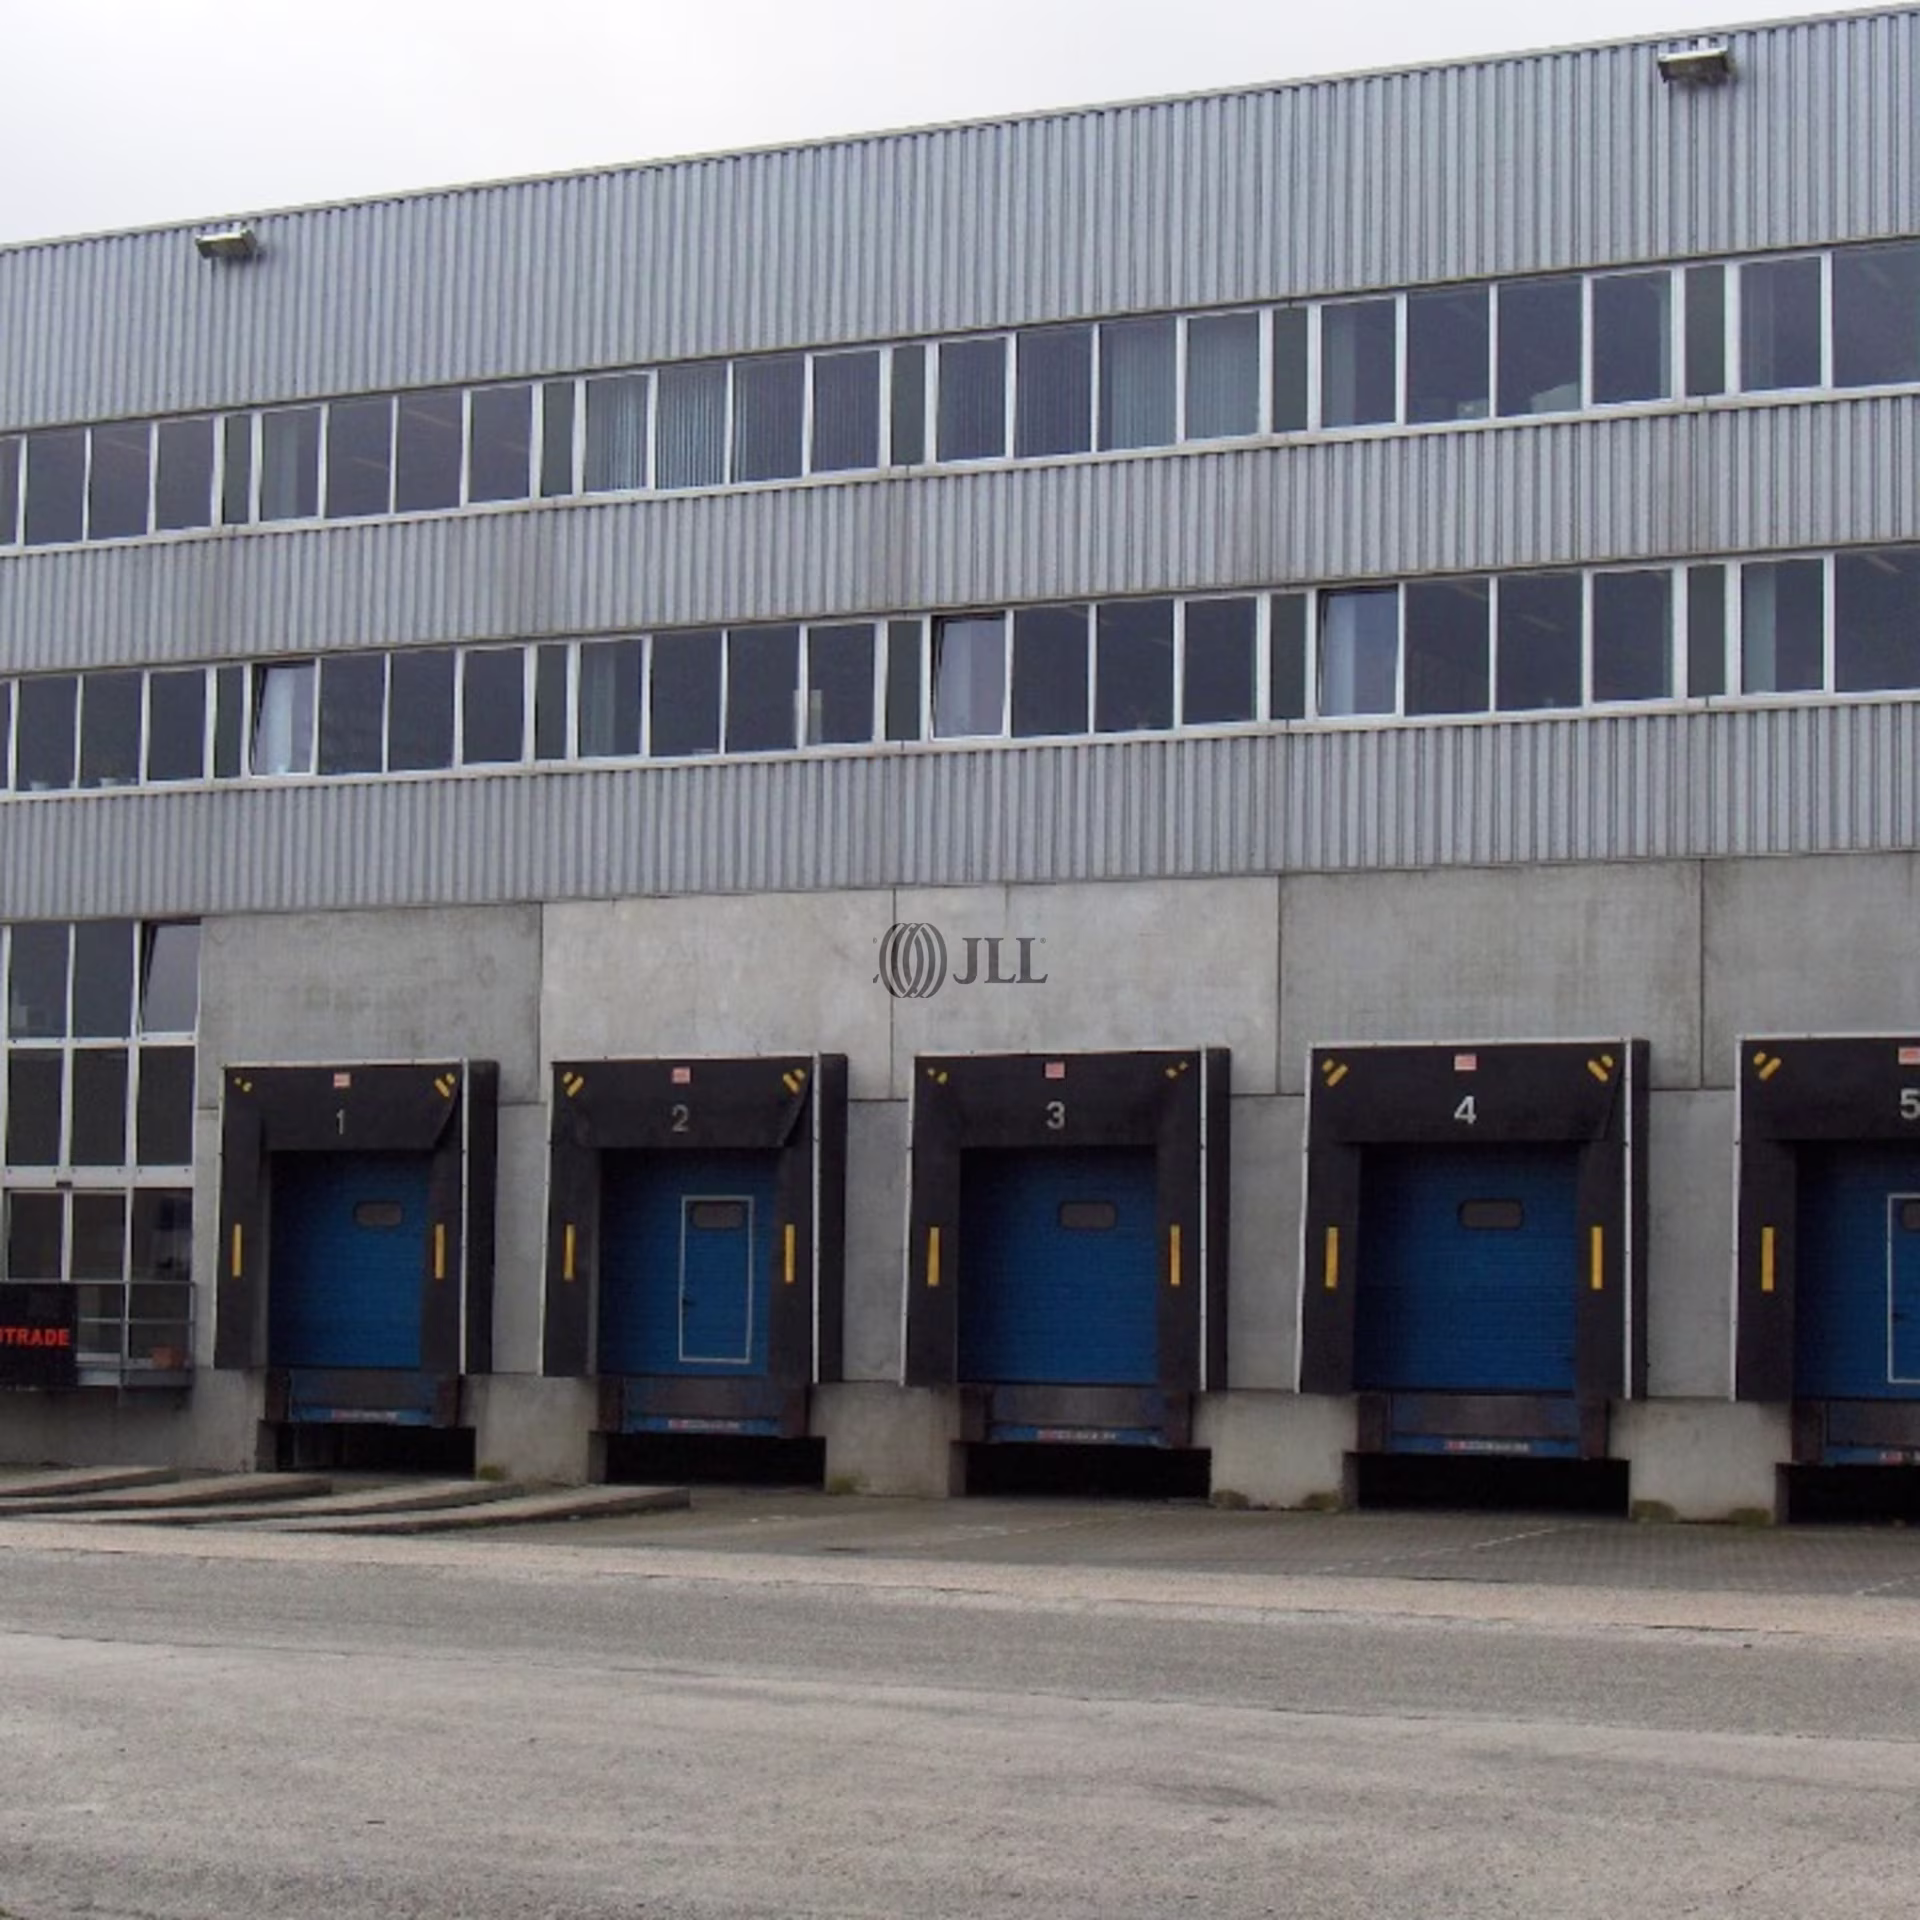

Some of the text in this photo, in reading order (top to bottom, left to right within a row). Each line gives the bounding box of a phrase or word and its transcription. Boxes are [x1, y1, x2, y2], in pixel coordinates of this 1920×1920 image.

[1046, 1101, 1065, 1129] 3
[1454, 1096, 1476, 1124] 4
[1901, 1088, 1920, 1119] 5
[336, 1109, 344, 1135] 1
[672, 1104, 689, 1132] 2
[0, 1327, 70, 1346] TRADE
